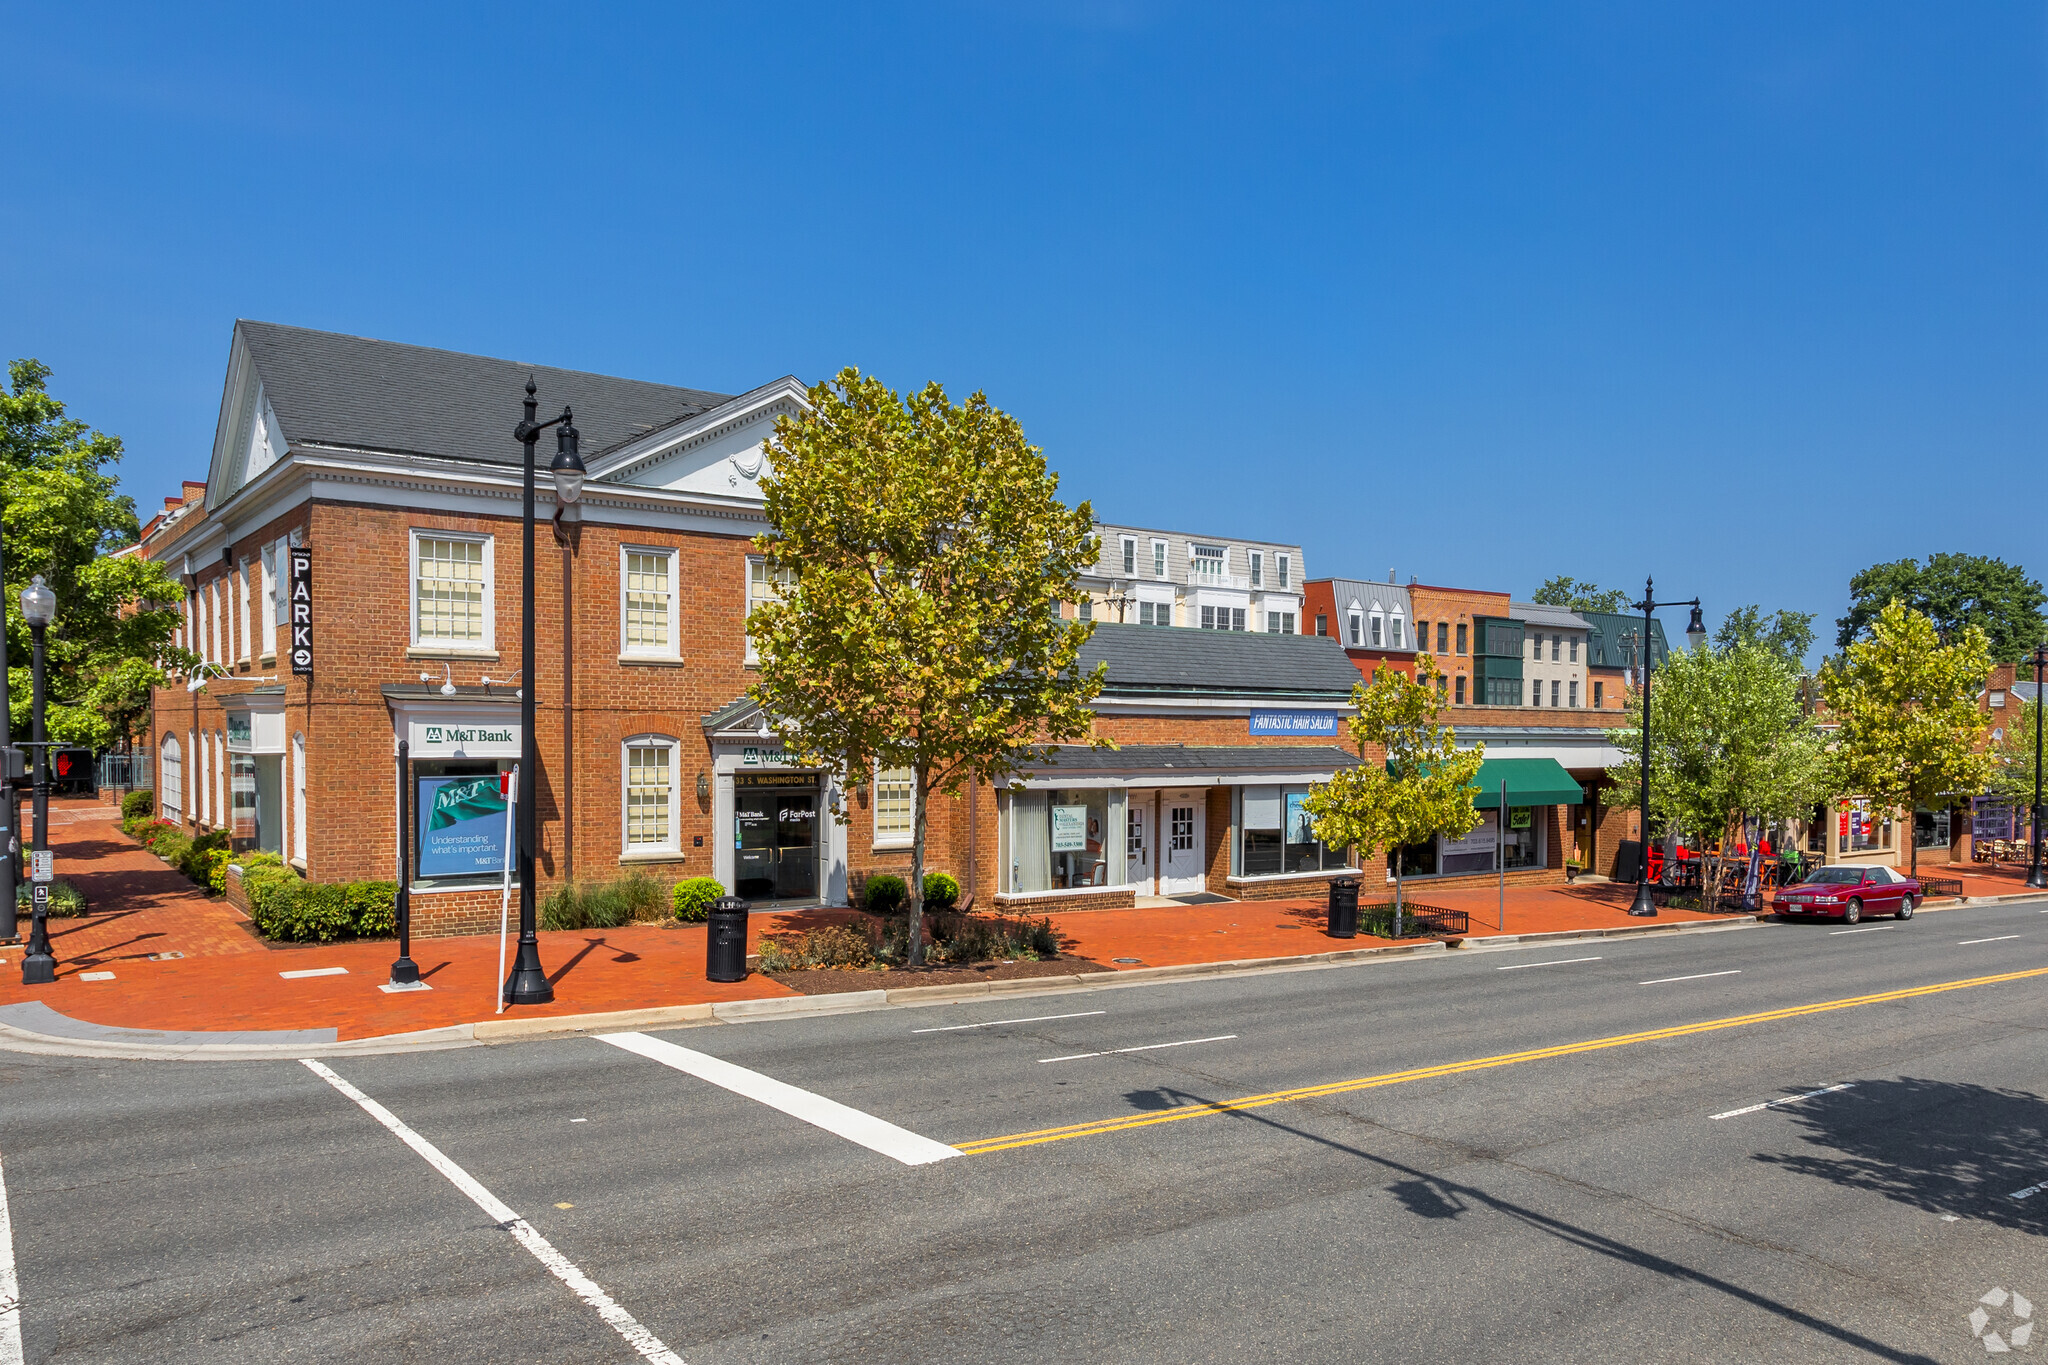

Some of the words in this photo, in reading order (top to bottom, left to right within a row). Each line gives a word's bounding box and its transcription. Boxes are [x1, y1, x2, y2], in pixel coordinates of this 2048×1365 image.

[293, 558, 311, 646] PARK
[1253, 714, 1292, 729] FANTASTIC
[1292, 715, 1310, 730] HAIR
[1310, 715, 1335, 730] SALON
[446, 729, 476, 742] M&T
[478, 729, 513, 742] Bank
[747, 776, 754, 785] S.
[757, 776, 804, 785] WASHINGTON
[808, 776, 817, 784] ST.
[436, 780, 485, 810] M&T
[789, 810, 816, 818] FarPost
[1513, 813, 1530, 826] Sale!
[431, 835, 489, 844] Understanding
[431, 845, 458, 854] what's
[459, 844, 498, 854] important.
[491, 857, 506, 865] Ban
